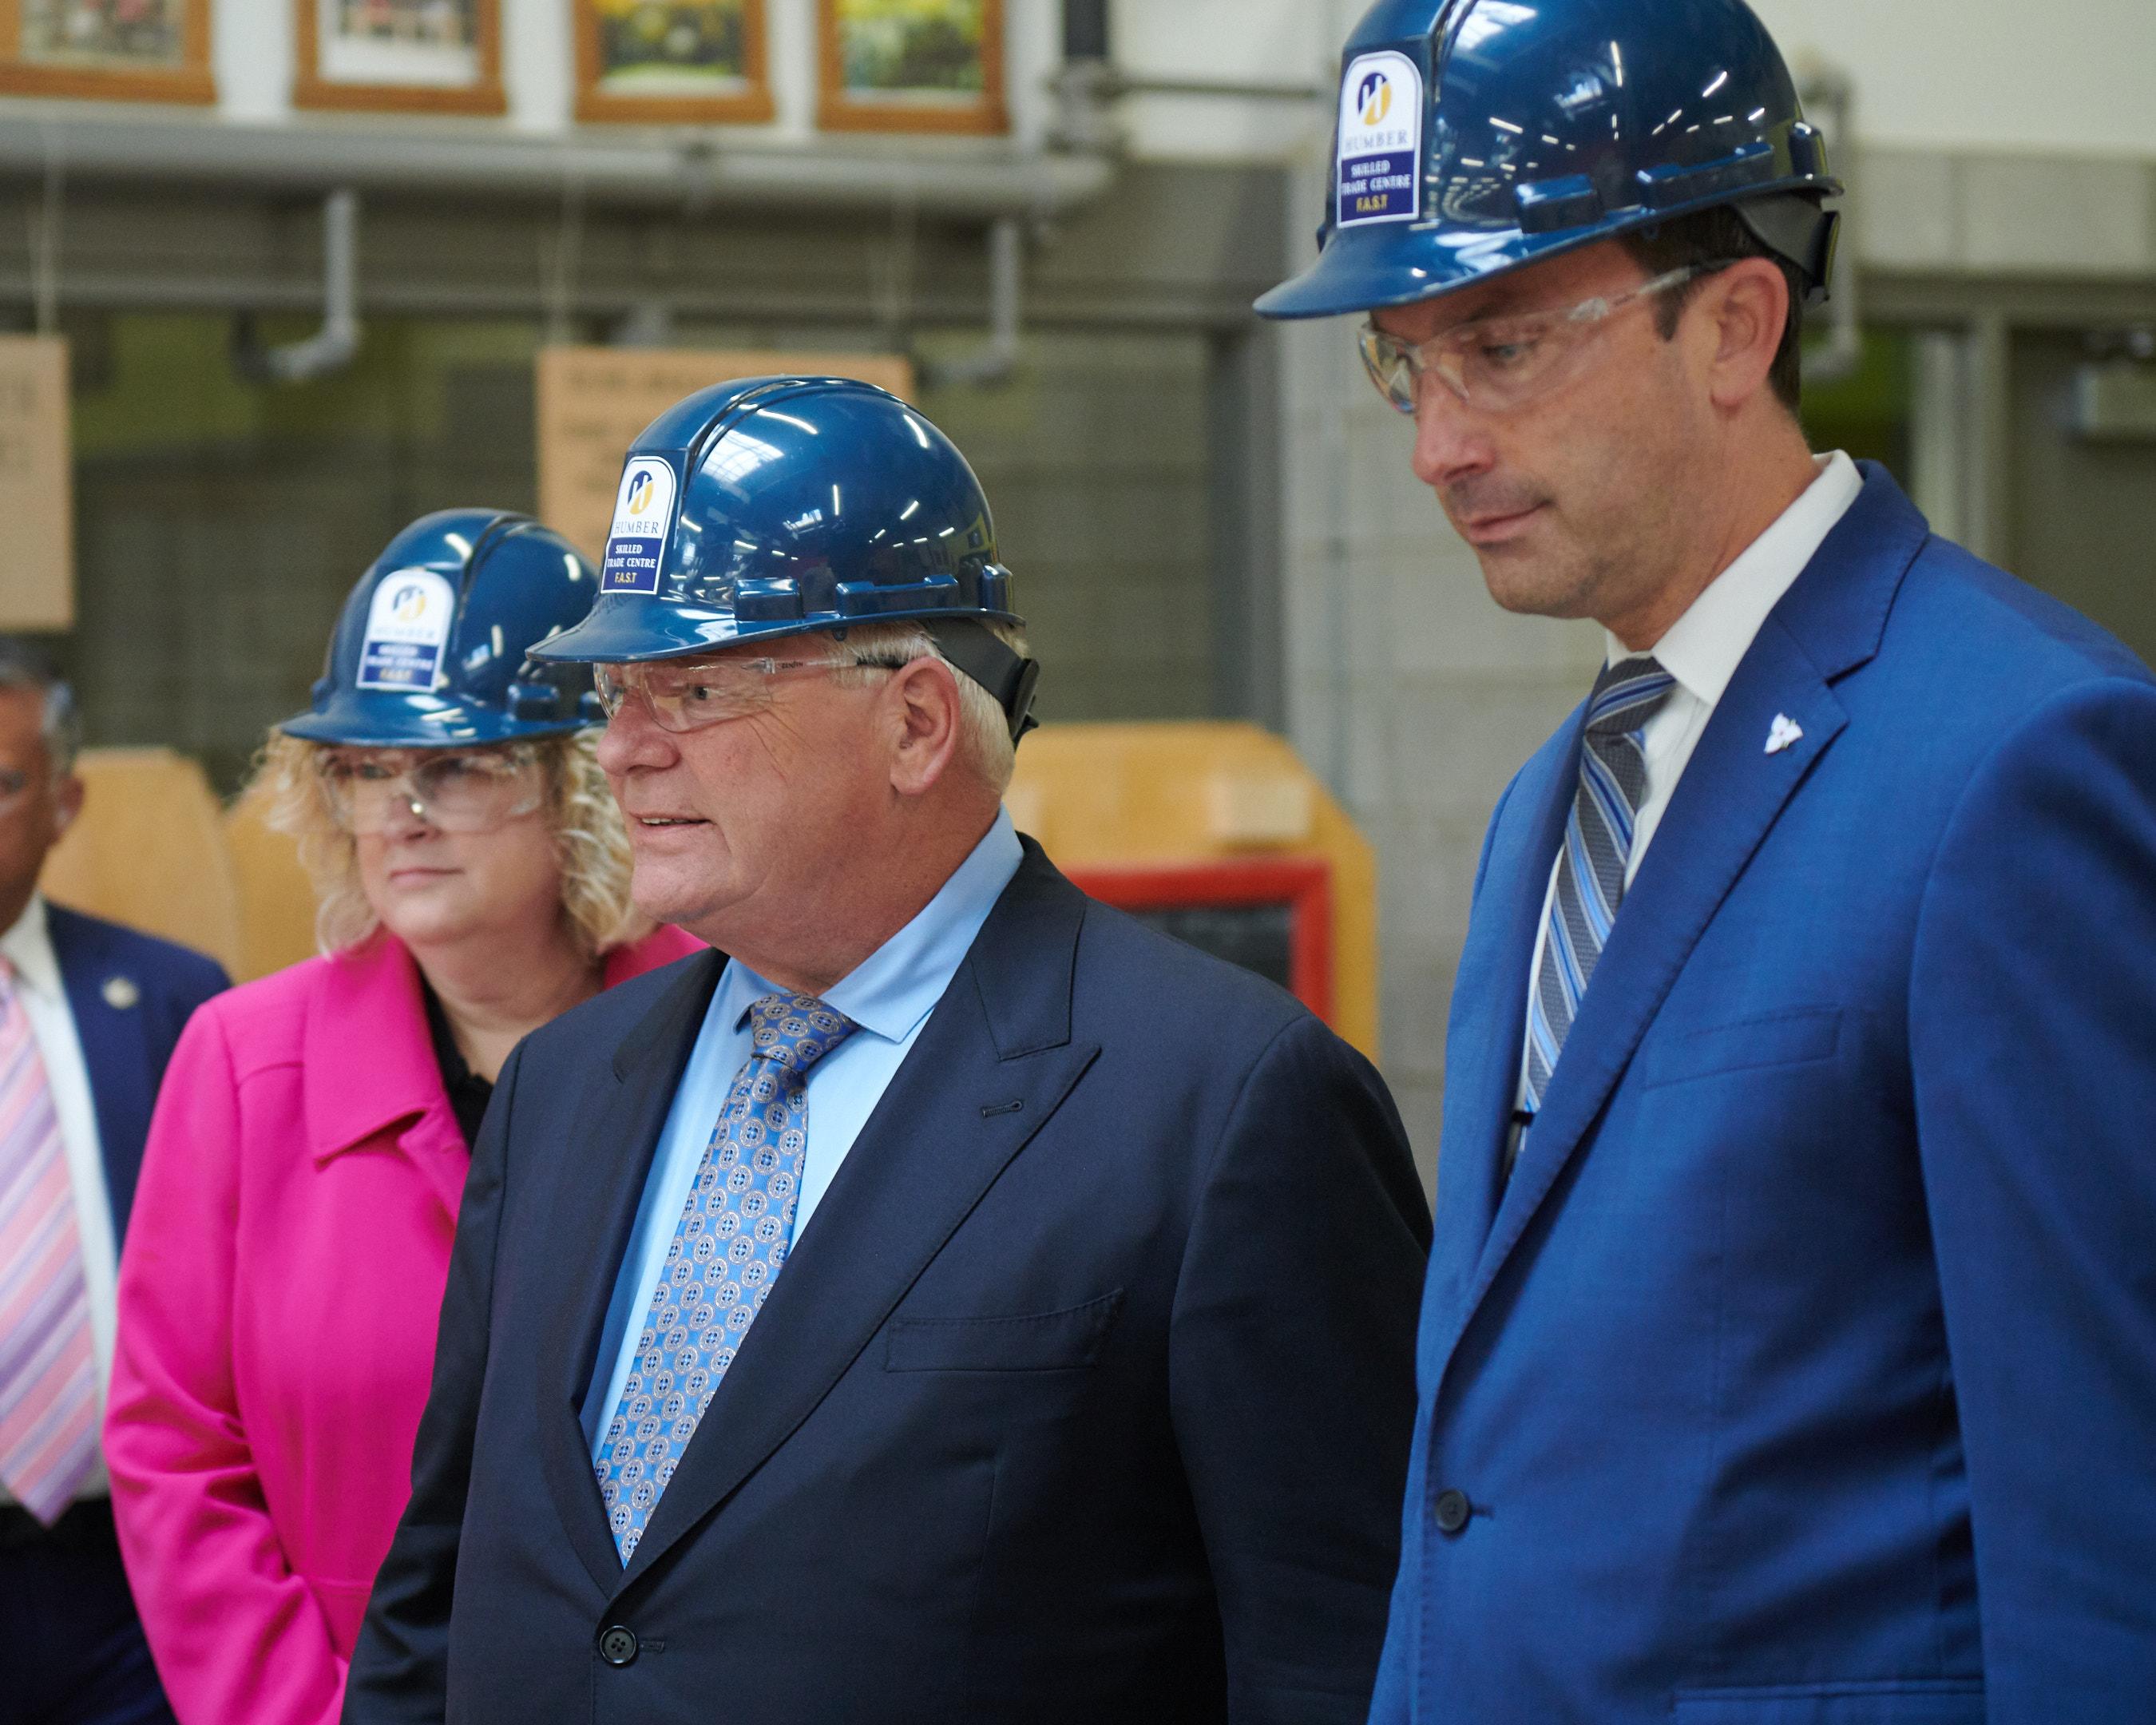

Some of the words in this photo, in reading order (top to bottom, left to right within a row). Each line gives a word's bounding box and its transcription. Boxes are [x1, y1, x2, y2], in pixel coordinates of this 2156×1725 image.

[1346, 130, 1407, 150] HUMBER
[1351, 160, 1390, 177] SKILLED
[1369, 174, 1411, 192] CENTRE
[614, 521, 659, 534] HUMBER
[616, 545, 642, 553] SKILLED
[607, 558, 624, 568] TRADE
[627, 557, 656, 568] CENTRE
